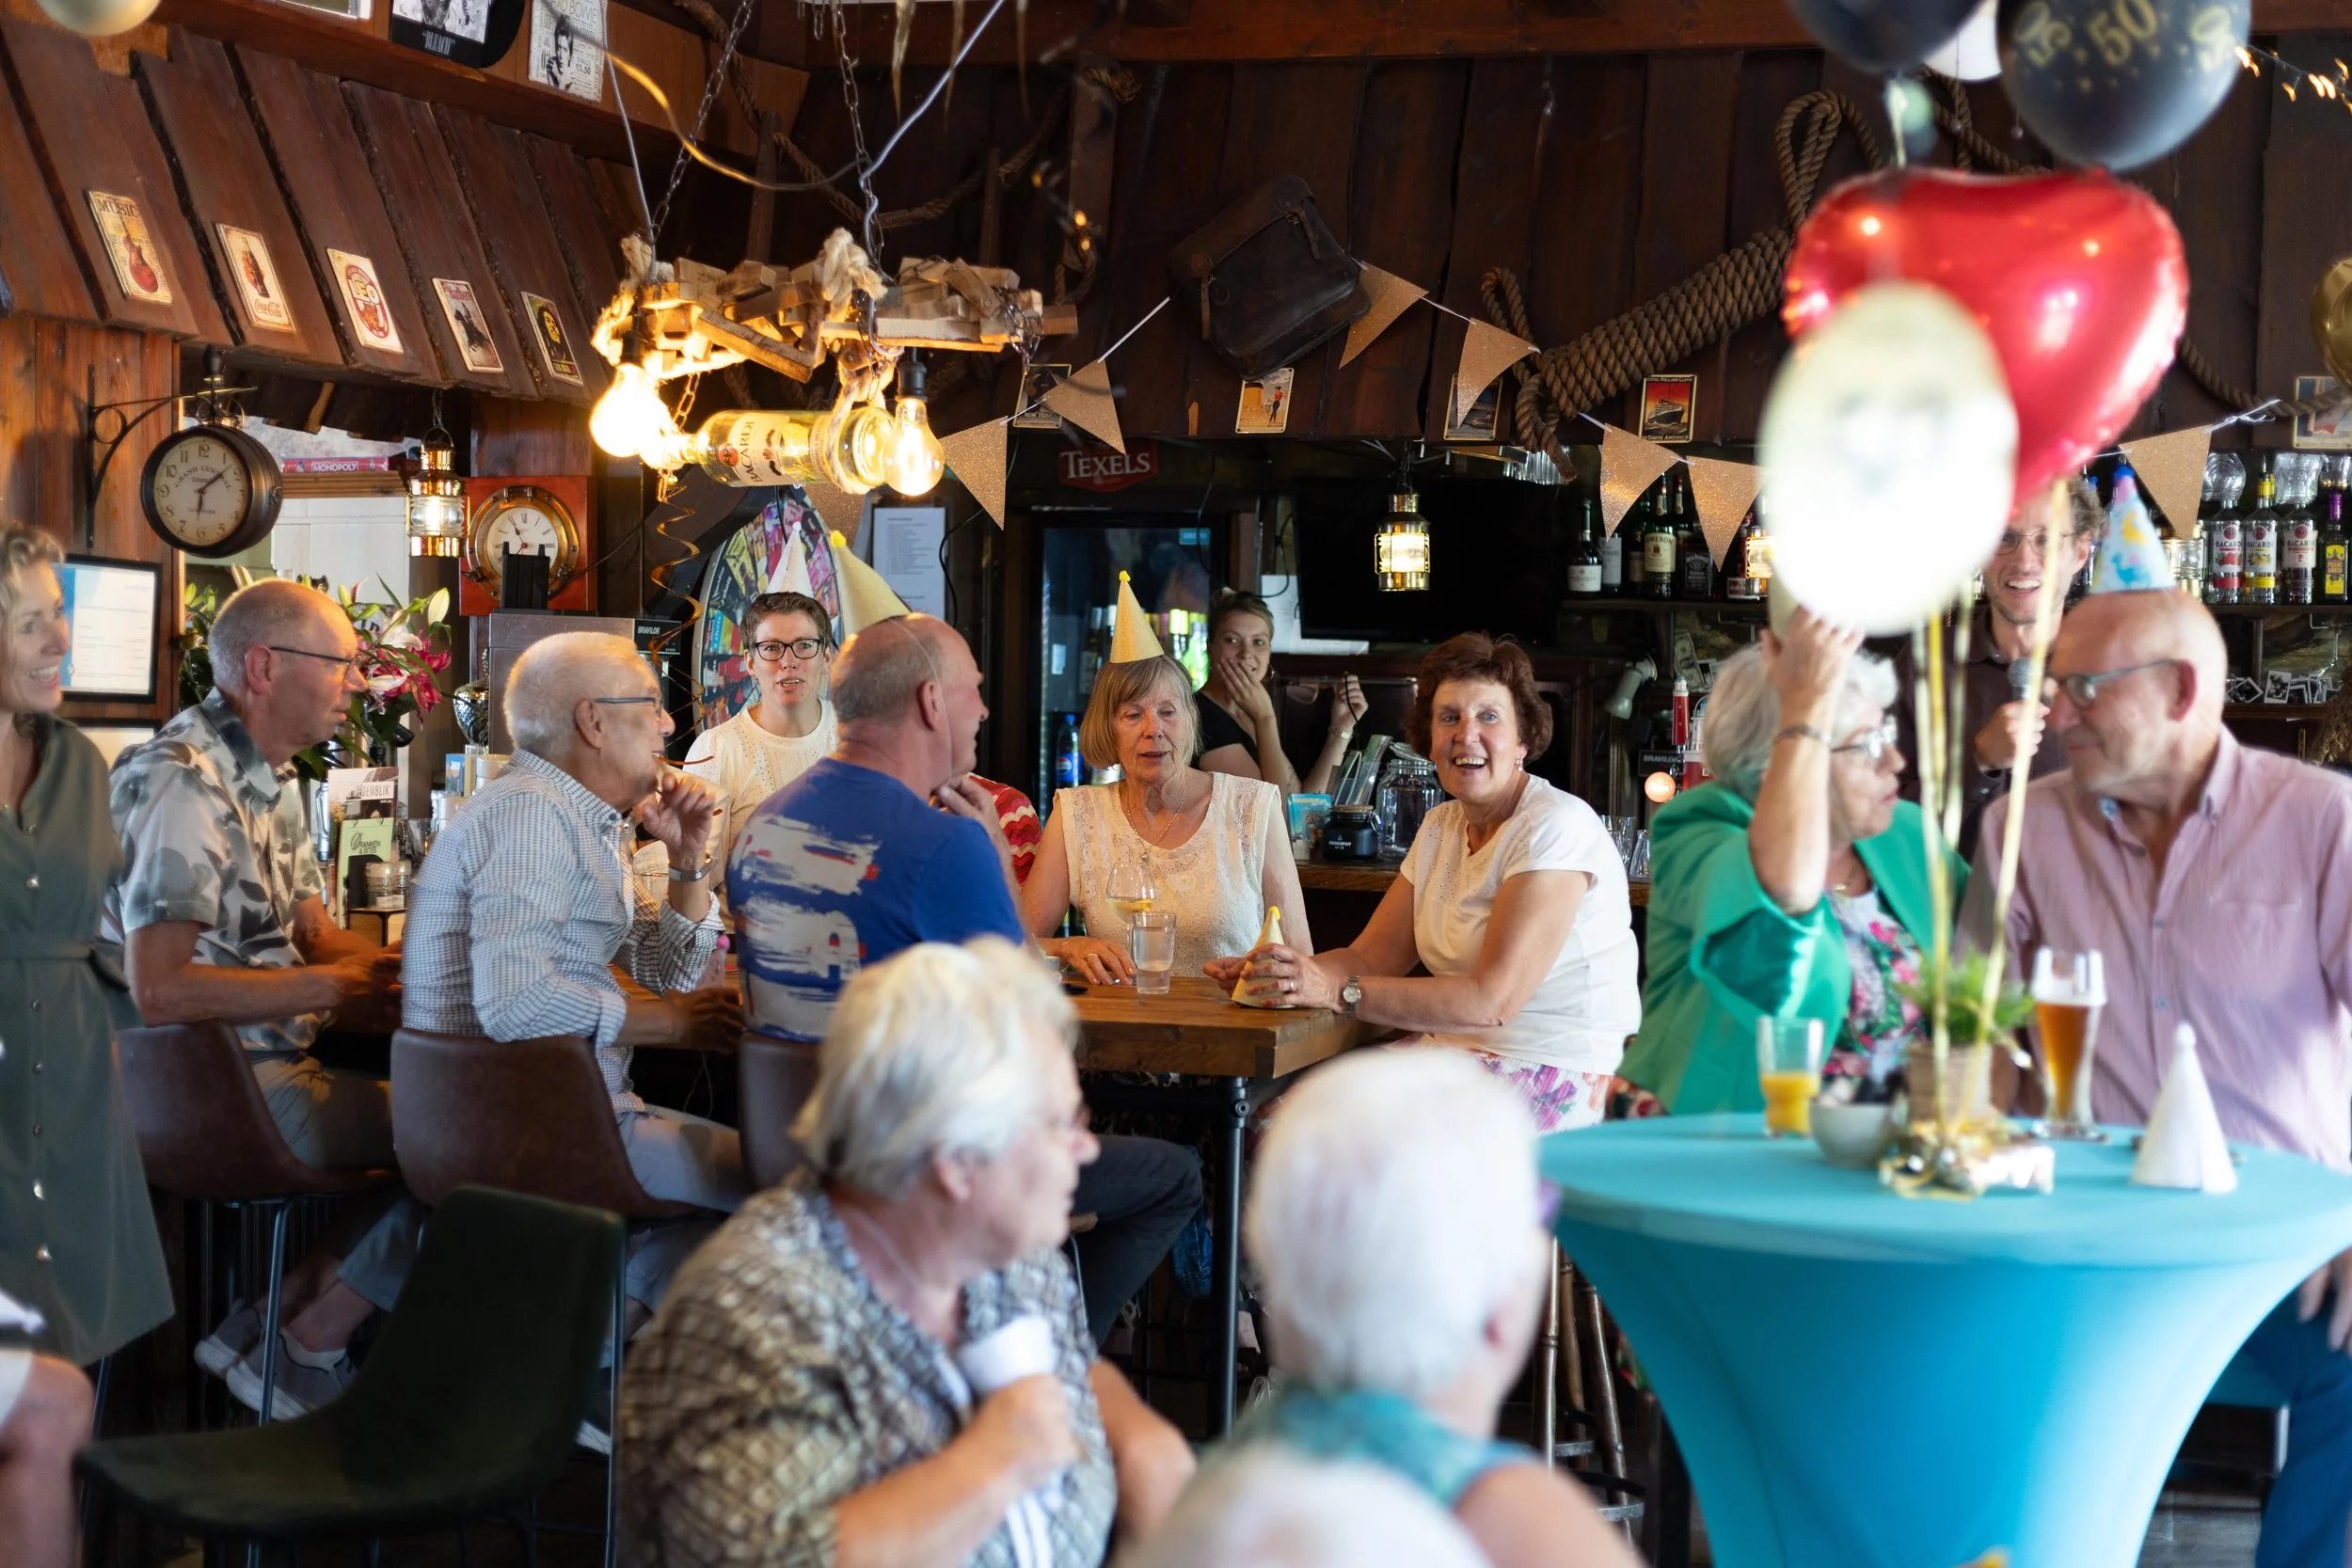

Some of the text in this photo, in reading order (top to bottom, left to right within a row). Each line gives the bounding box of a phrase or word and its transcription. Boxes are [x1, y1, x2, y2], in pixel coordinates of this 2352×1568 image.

[2087, 0, 2157, 67] 50
[96, 198, 139, 219] MUSIC
[739, 420, 763, 483] BACARDI
[312, 462, 358, 472] MONOPOLY
[1059, 451, 1151, 480] TEXELS
[637, 626, 660, 635] BRAVILOR
[350, 832, 381, 850] DRANKEN
